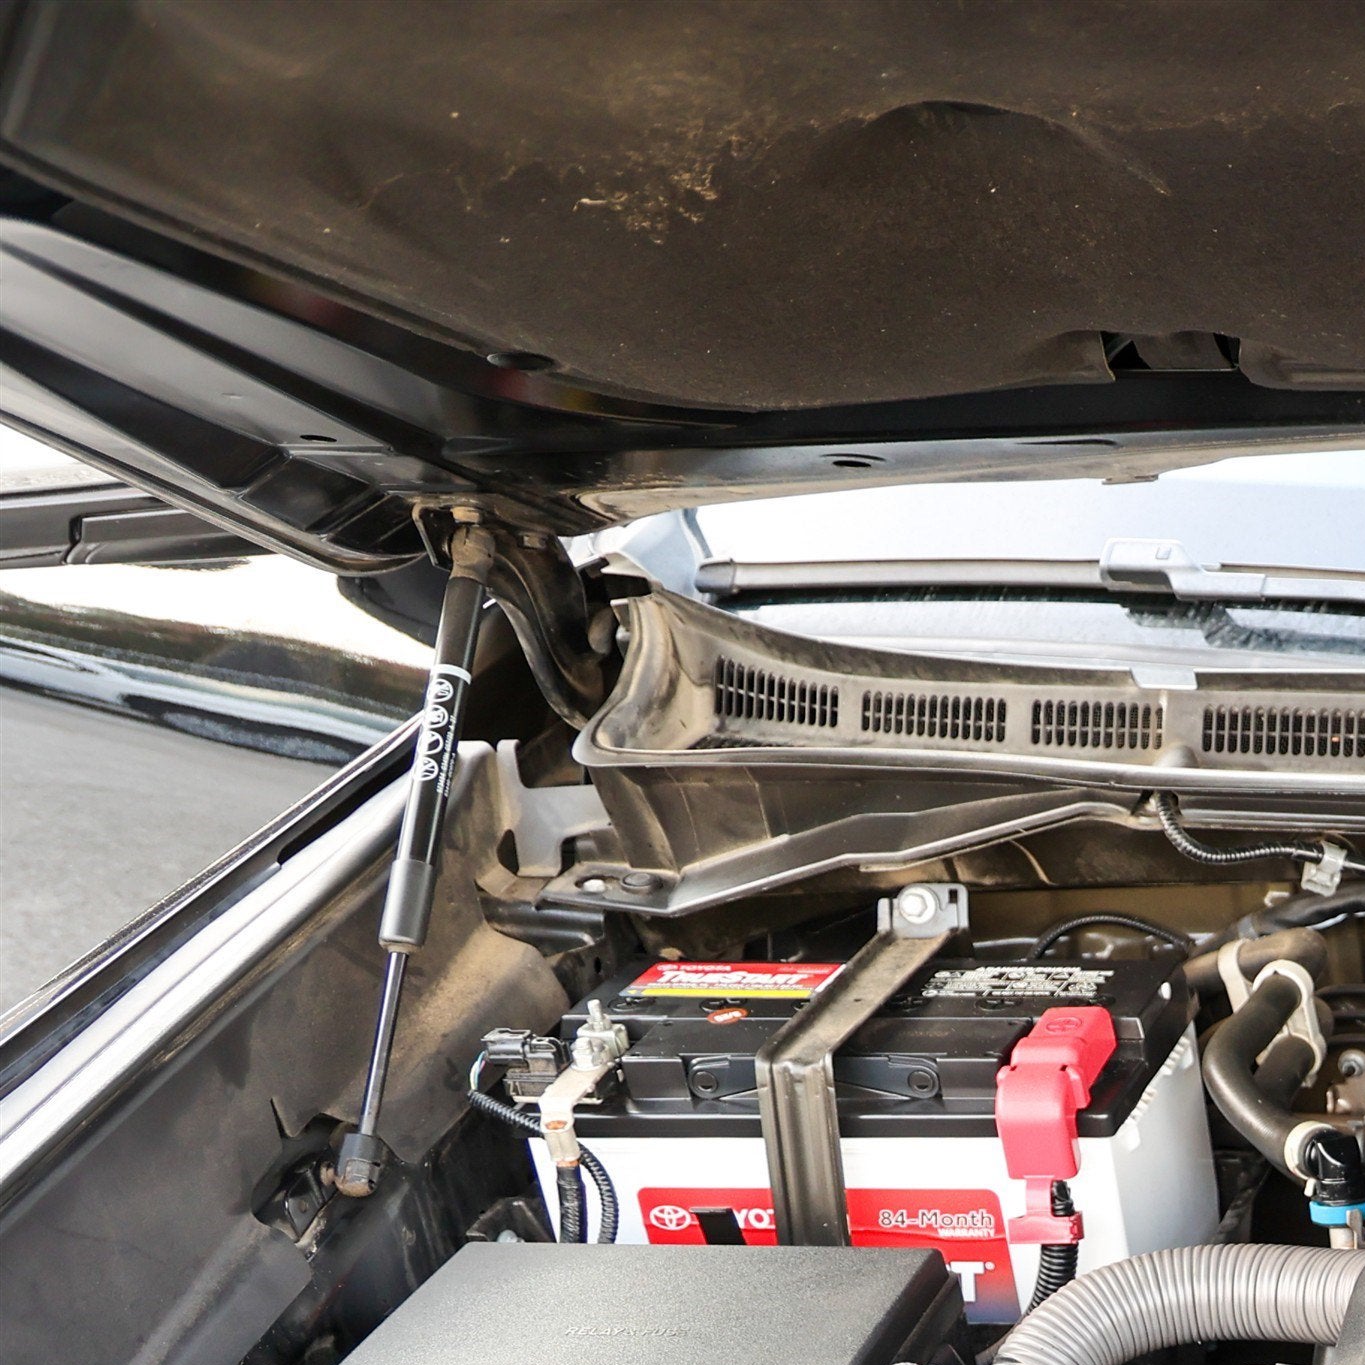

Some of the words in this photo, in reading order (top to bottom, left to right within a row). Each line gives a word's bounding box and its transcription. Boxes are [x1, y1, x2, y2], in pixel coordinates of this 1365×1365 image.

[879, 1209, 993, 1228] 84-Month
[937, 1228, 995, 1238] WARRANTY
[565, 1326, 626, 1337] RELAY
